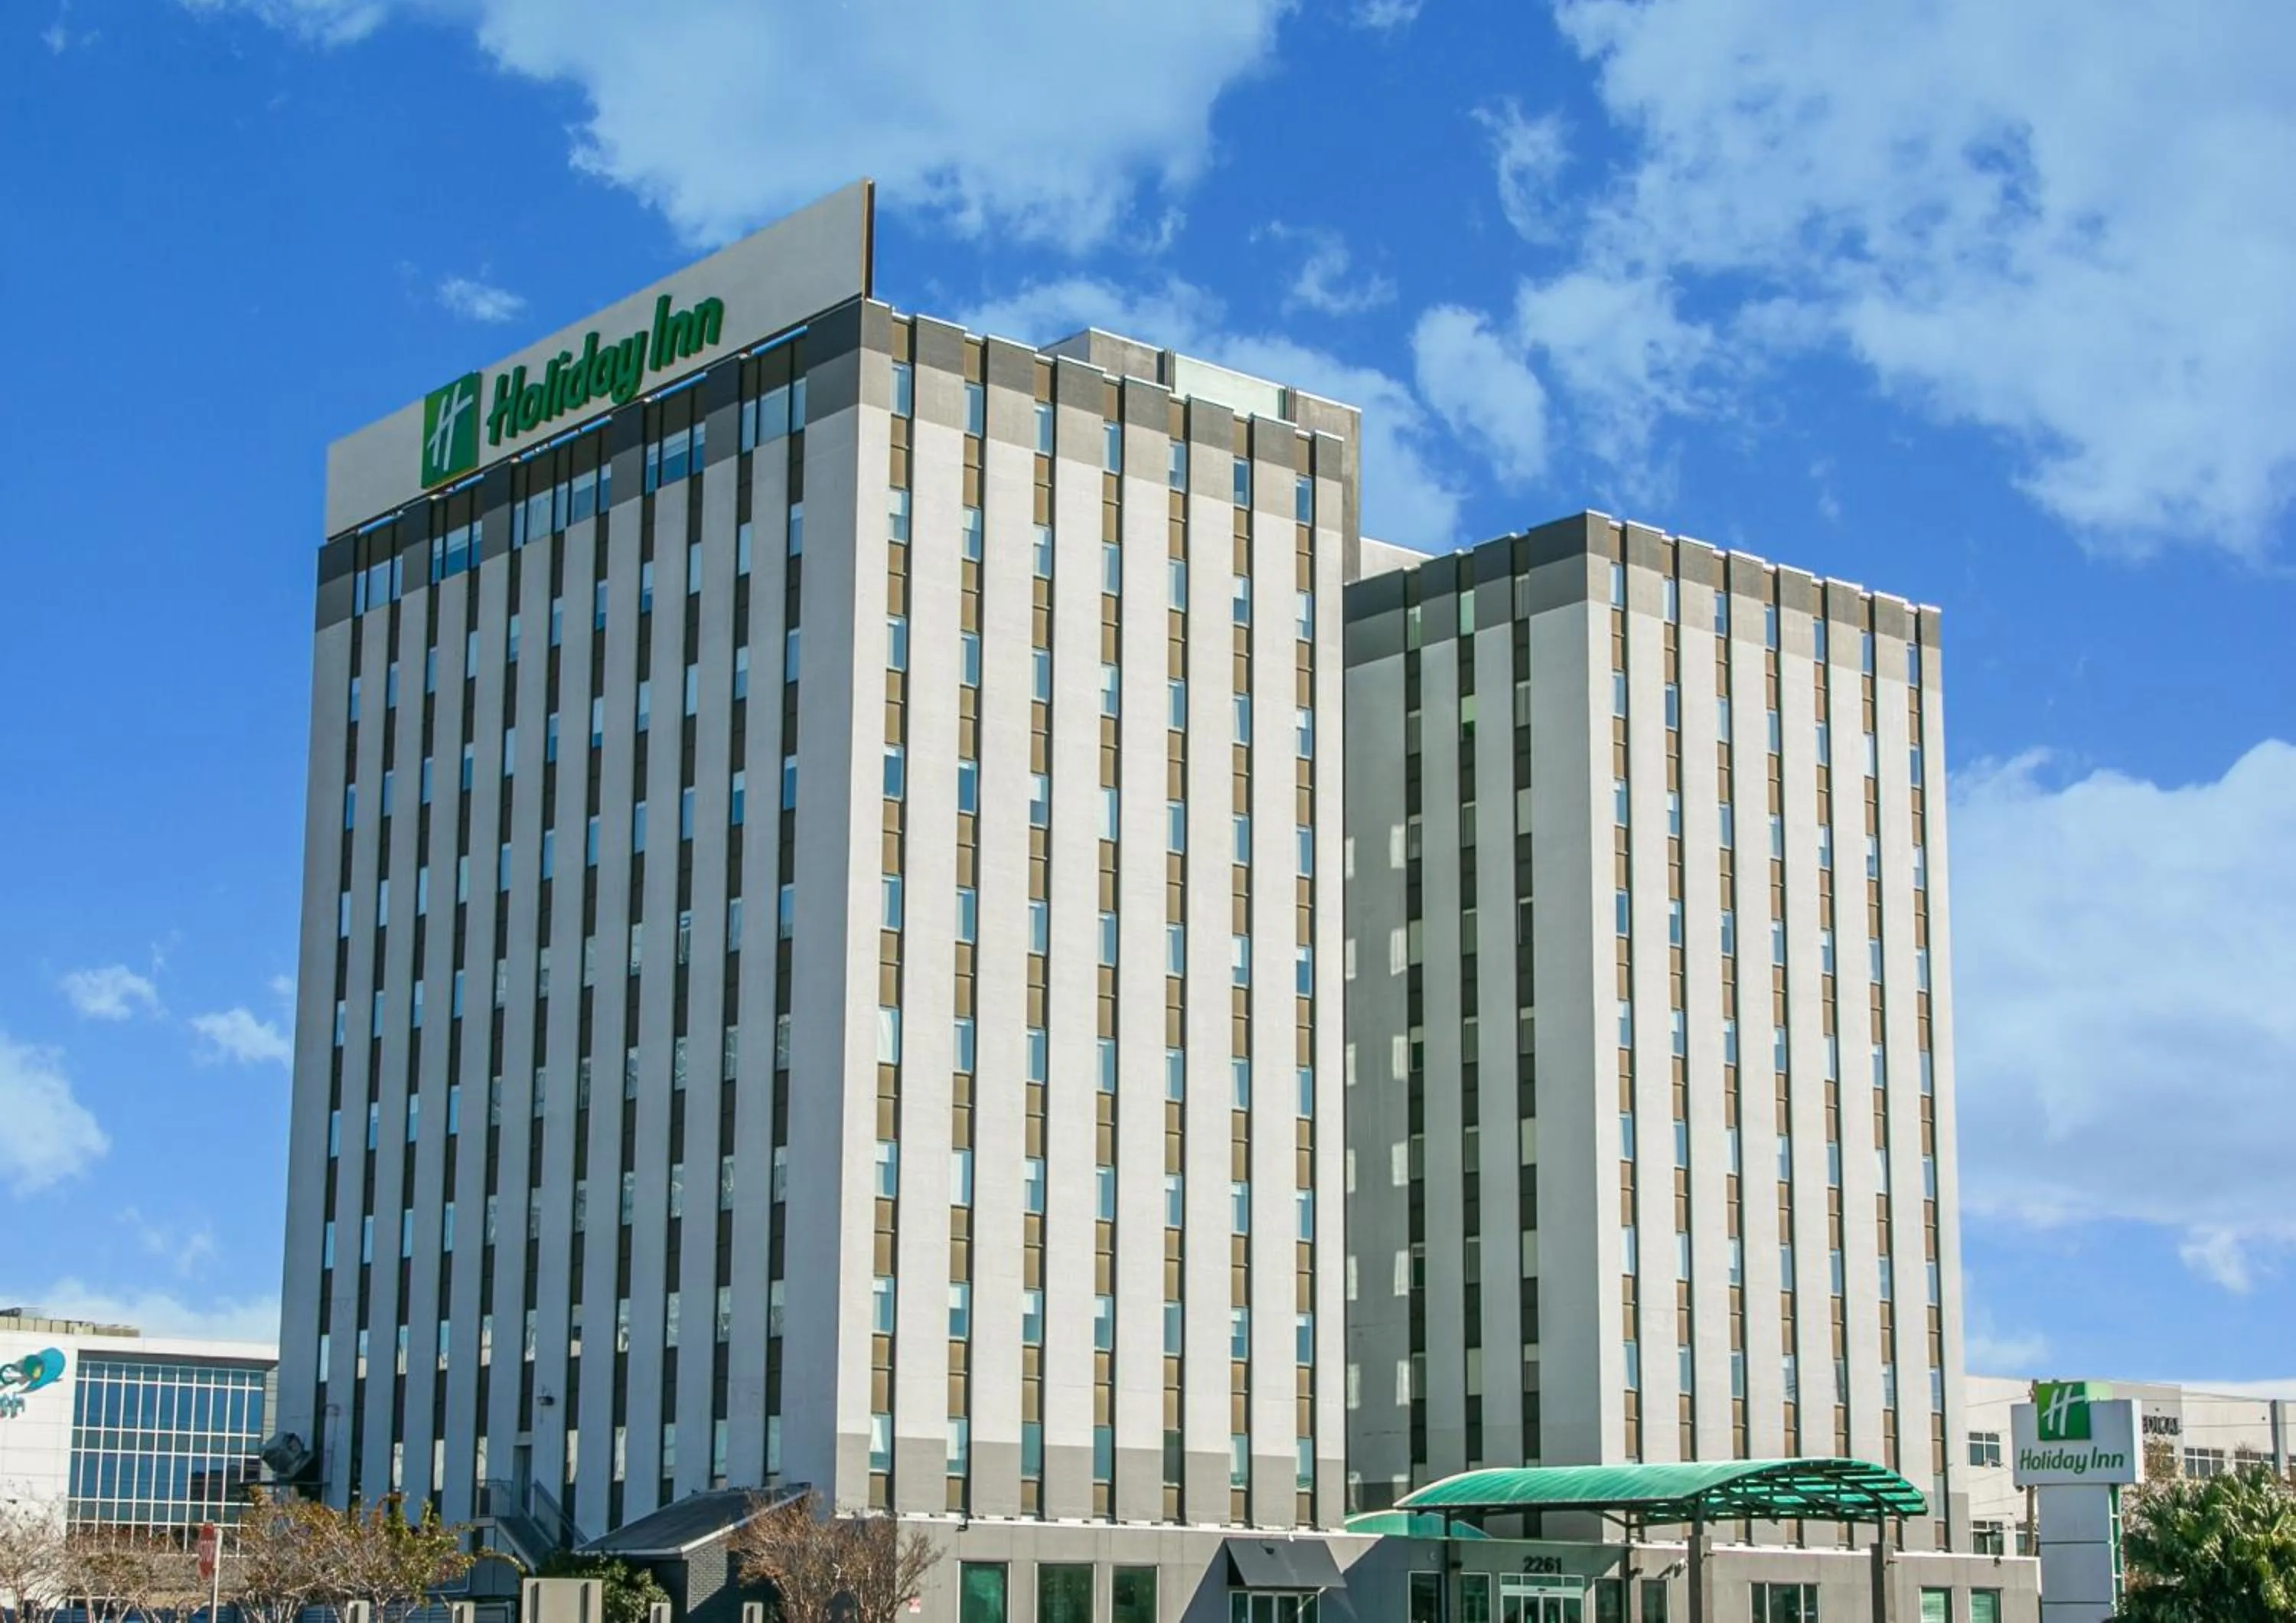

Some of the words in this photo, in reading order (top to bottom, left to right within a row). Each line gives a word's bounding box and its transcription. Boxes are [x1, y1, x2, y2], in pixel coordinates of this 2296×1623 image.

[487, 331, 649, 446] Holiday
[649, 294, 724, 371] Inn
[2142, 1415, 2182, 1435] EDICAL
[2020, 1448, 2088, 1474] Holiday
[2091, 1446, 2125, 1468] Inn
[1523, 1555, 1562, 1575] 2261
